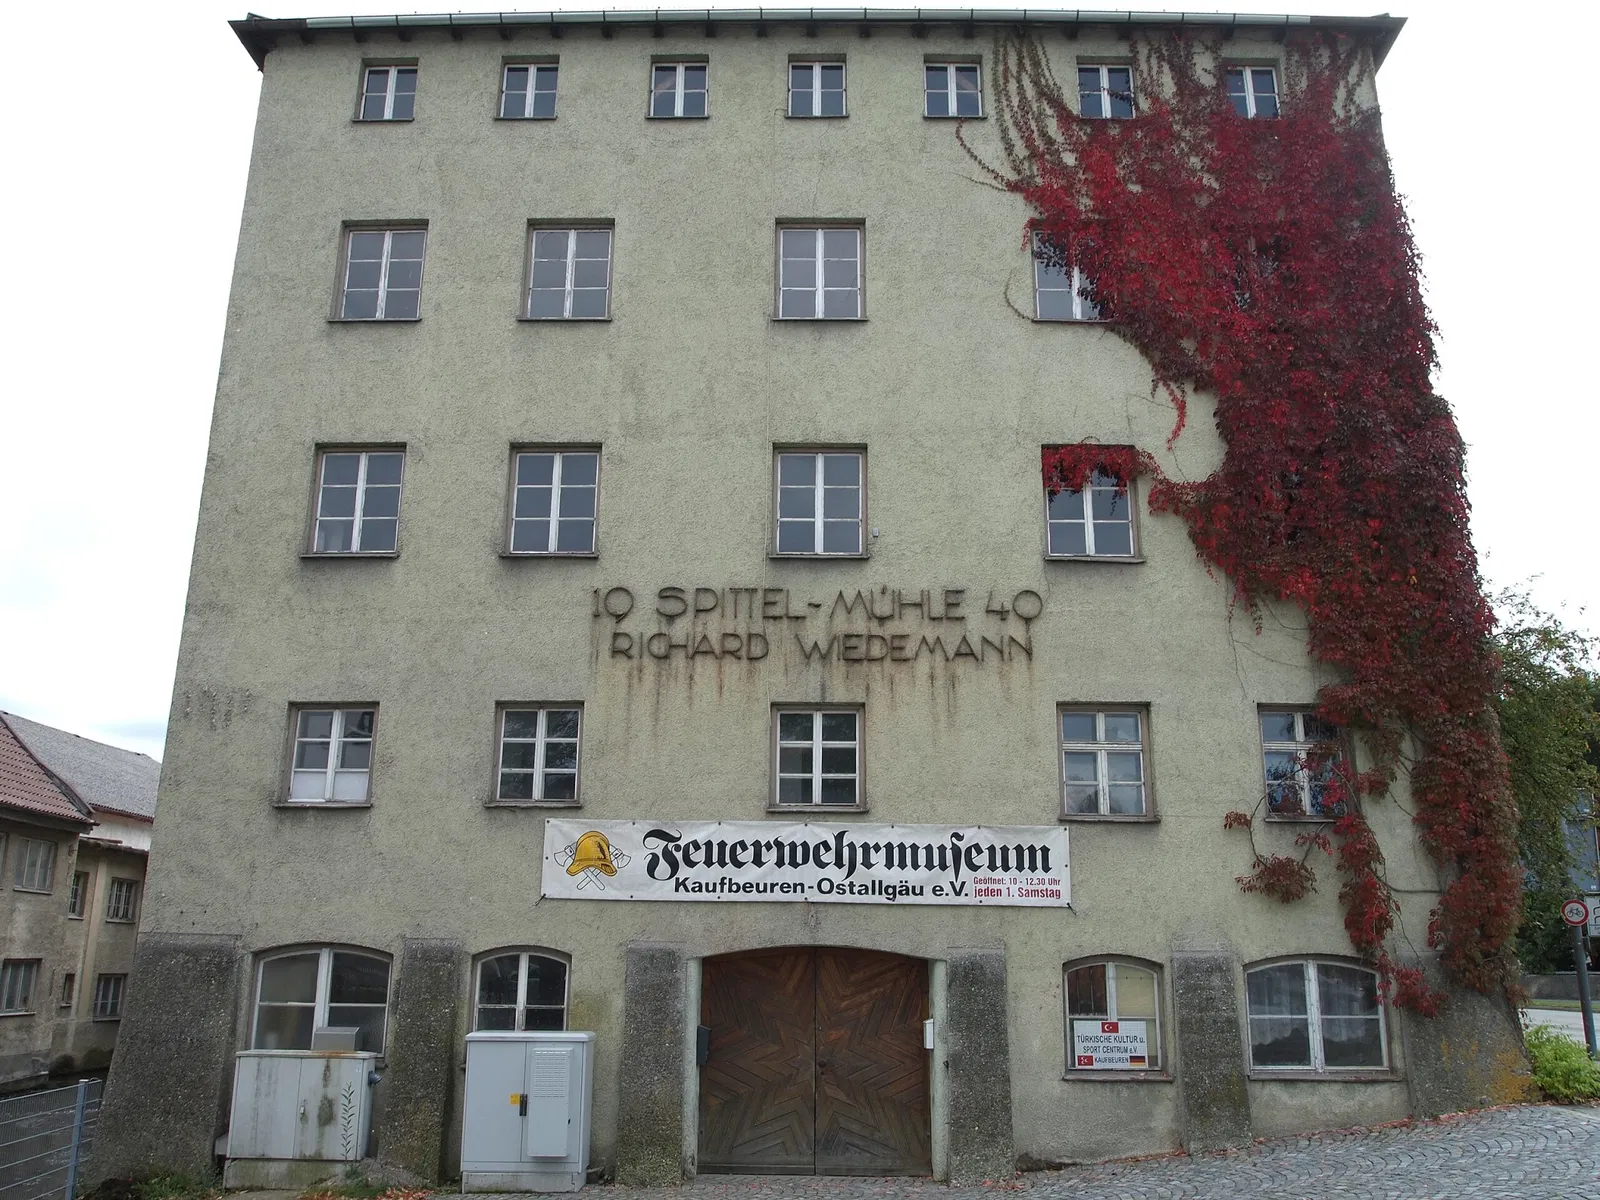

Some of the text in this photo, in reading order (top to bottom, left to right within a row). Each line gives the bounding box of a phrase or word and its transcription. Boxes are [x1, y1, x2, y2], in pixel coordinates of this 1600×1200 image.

[593, 587, 634, 624] 19
[986, 589, 1043, 620] 40
[611, 631, 1033, 661] RICHARD WIEDEMANN
[973, 876, 1006, 885] Geöffnet:
[1009, 877, 1018, 885] 10
[1025, 877, 1046, 886] 12.30
[1048, 877, 1061, 886] Uhr
[674, 876, 969, 900] Kaufbeuren-Ostallgäu e.V.
[974, 886, 1061, 900] jeden 1. Samstag
[1077, 1034, 1112, 1043] TÜRKISCHE
[1113, 1035, 1138, 1044] KULTUR
[1083, 1046, 1101, 1054] SPORT
[1102, 1046, 1128, 1054] CENTRUM
[1094, 1055, 1129, 1063] KAUFBEUREN
